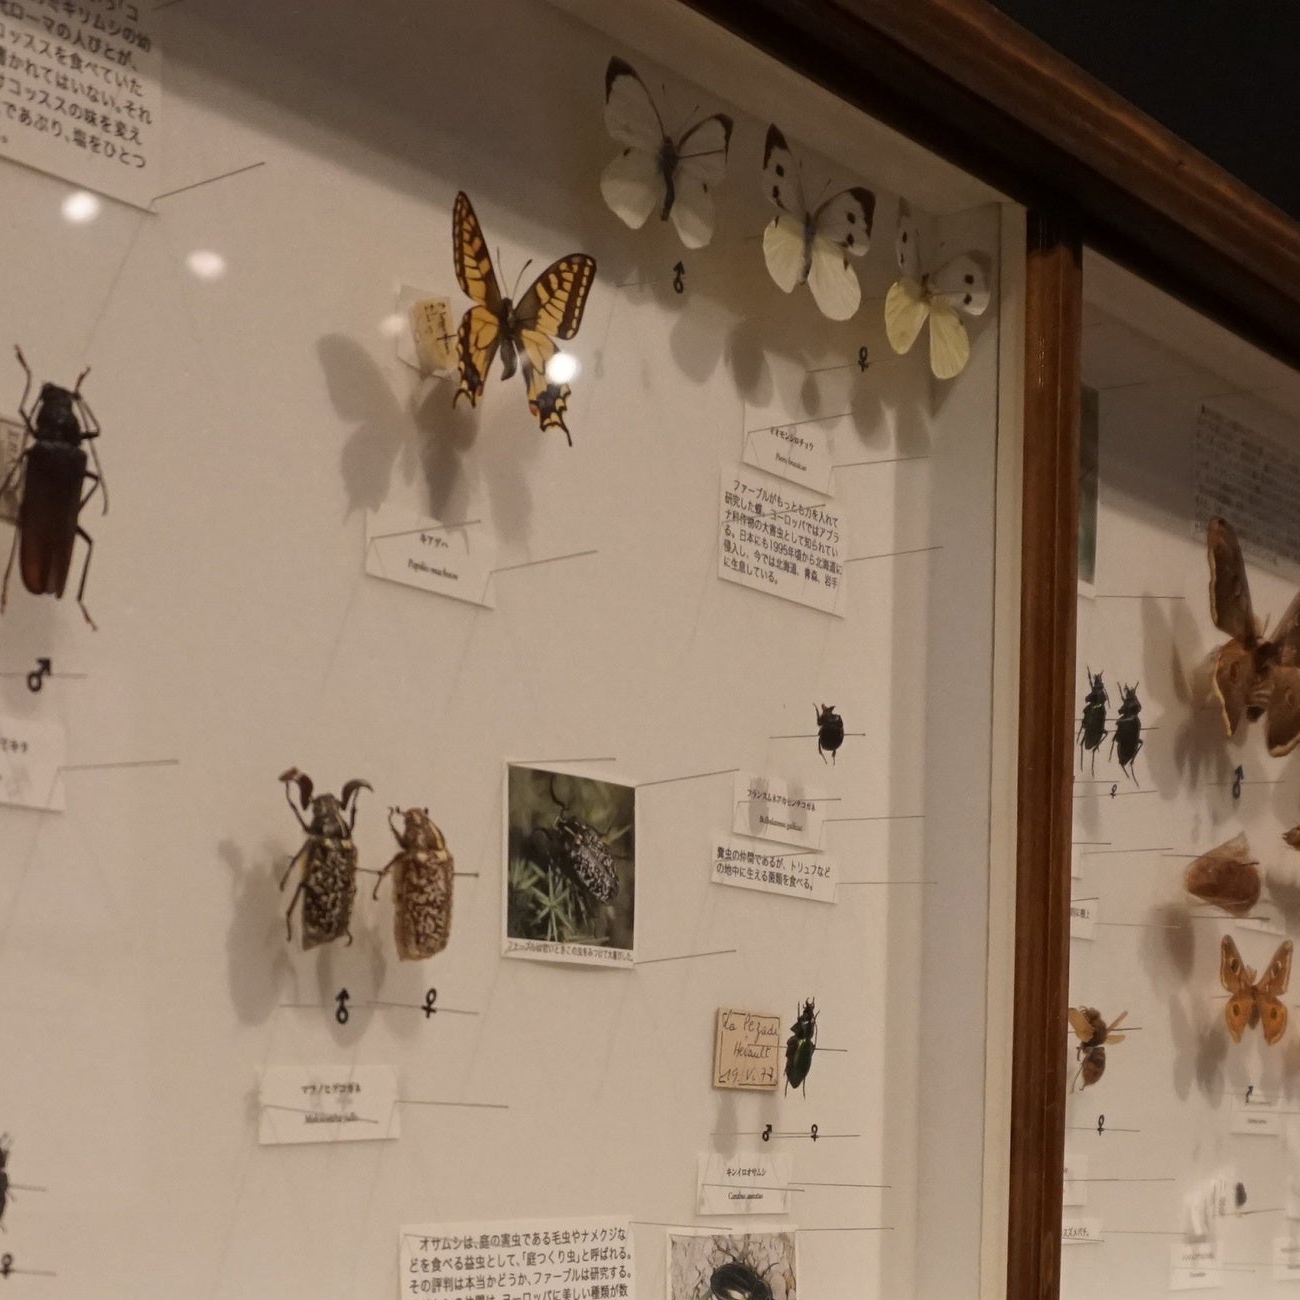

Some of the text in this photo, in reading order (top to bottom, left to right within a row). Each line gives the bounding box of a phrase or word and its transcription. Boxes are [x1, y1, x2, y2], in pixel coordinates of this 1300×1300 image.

[734, 480, 838, 528] ファーブルがもっとも力を入れて
[724, 557, 778, 584] に生息している。
[717, 847, 831, 878] 糞虫の仲間であるが、トリュフなど
[716, 862, 813, 891] の地中に生える菌類を食べる。
[726, 1168, 766, 1176] キンイロオサムシ
[419, 1228, 626, 1251] オサムシは、庭の害虫である毛虫やナメクジな
[409, 1247, 631, 1273] どを食べる益虫として、「庭つくり虫」と呼ばれる。
[409, 1266, 631, 1294] その評判は本当かどうか、ファーブルは研究する。
